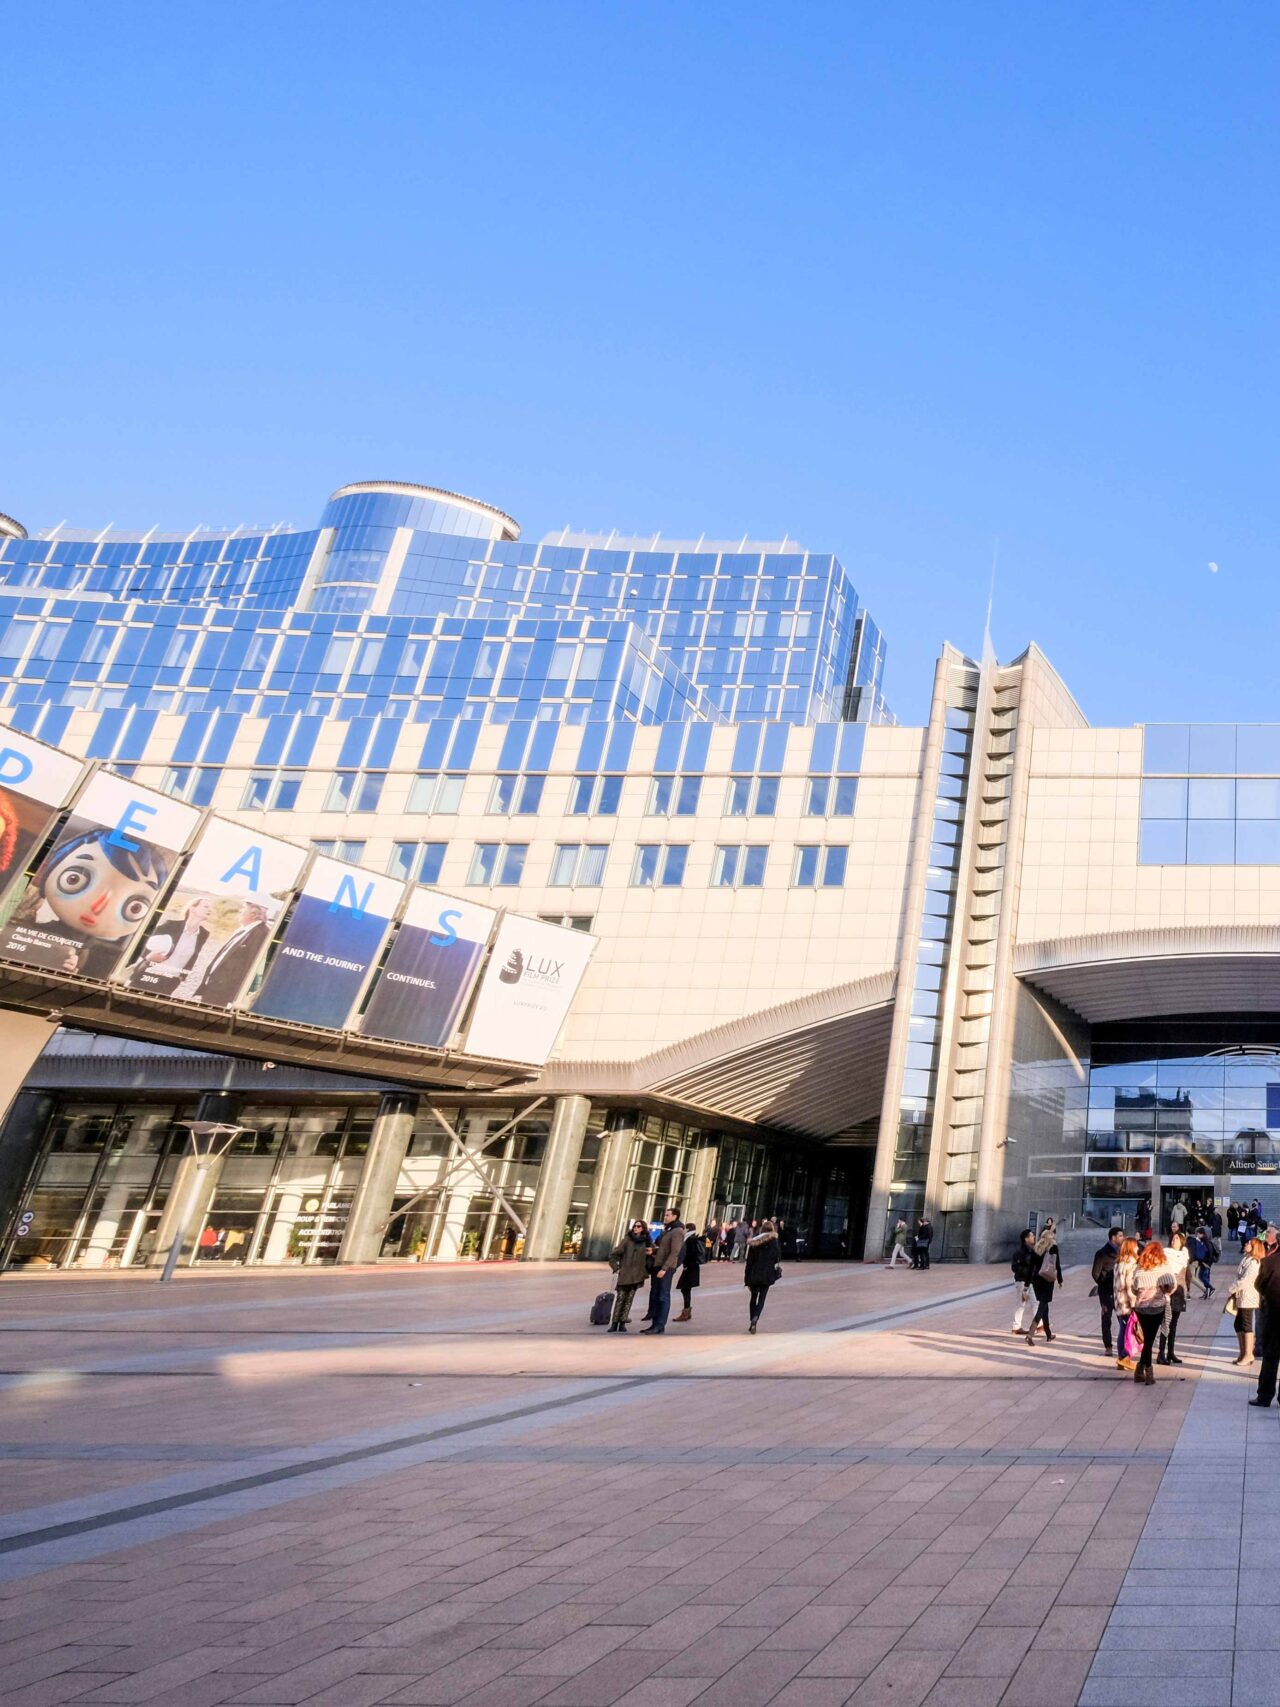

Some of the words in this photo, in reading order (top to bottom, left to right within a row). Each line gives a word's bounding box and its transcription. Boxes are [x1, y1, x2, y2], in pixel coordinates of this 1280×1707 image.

[0, 747, 33, 785] D
[107, 800, 158, 853] E
[219, 845, 263, 893] A
[327, 874, 376, 920] N
[27, 928, 40, 937] VIE
[39, 931, 48, 939] DE
[429, 909, 463, 947] S
[5, 941, 28, 952] 2016
[282, 946, 305, 958] AND
[305, 951, 323, 963] THE
[323, 956, 366, 973] JOURNEY
[526, 954, 566, 978] LUX
[140, 974, 160, 984] 2016
[386, 971, 437, 990] CONTINUES.
[540, 974, 561, 984] PRIZE
[1229, 1160, 1256, 1169] Altiero
